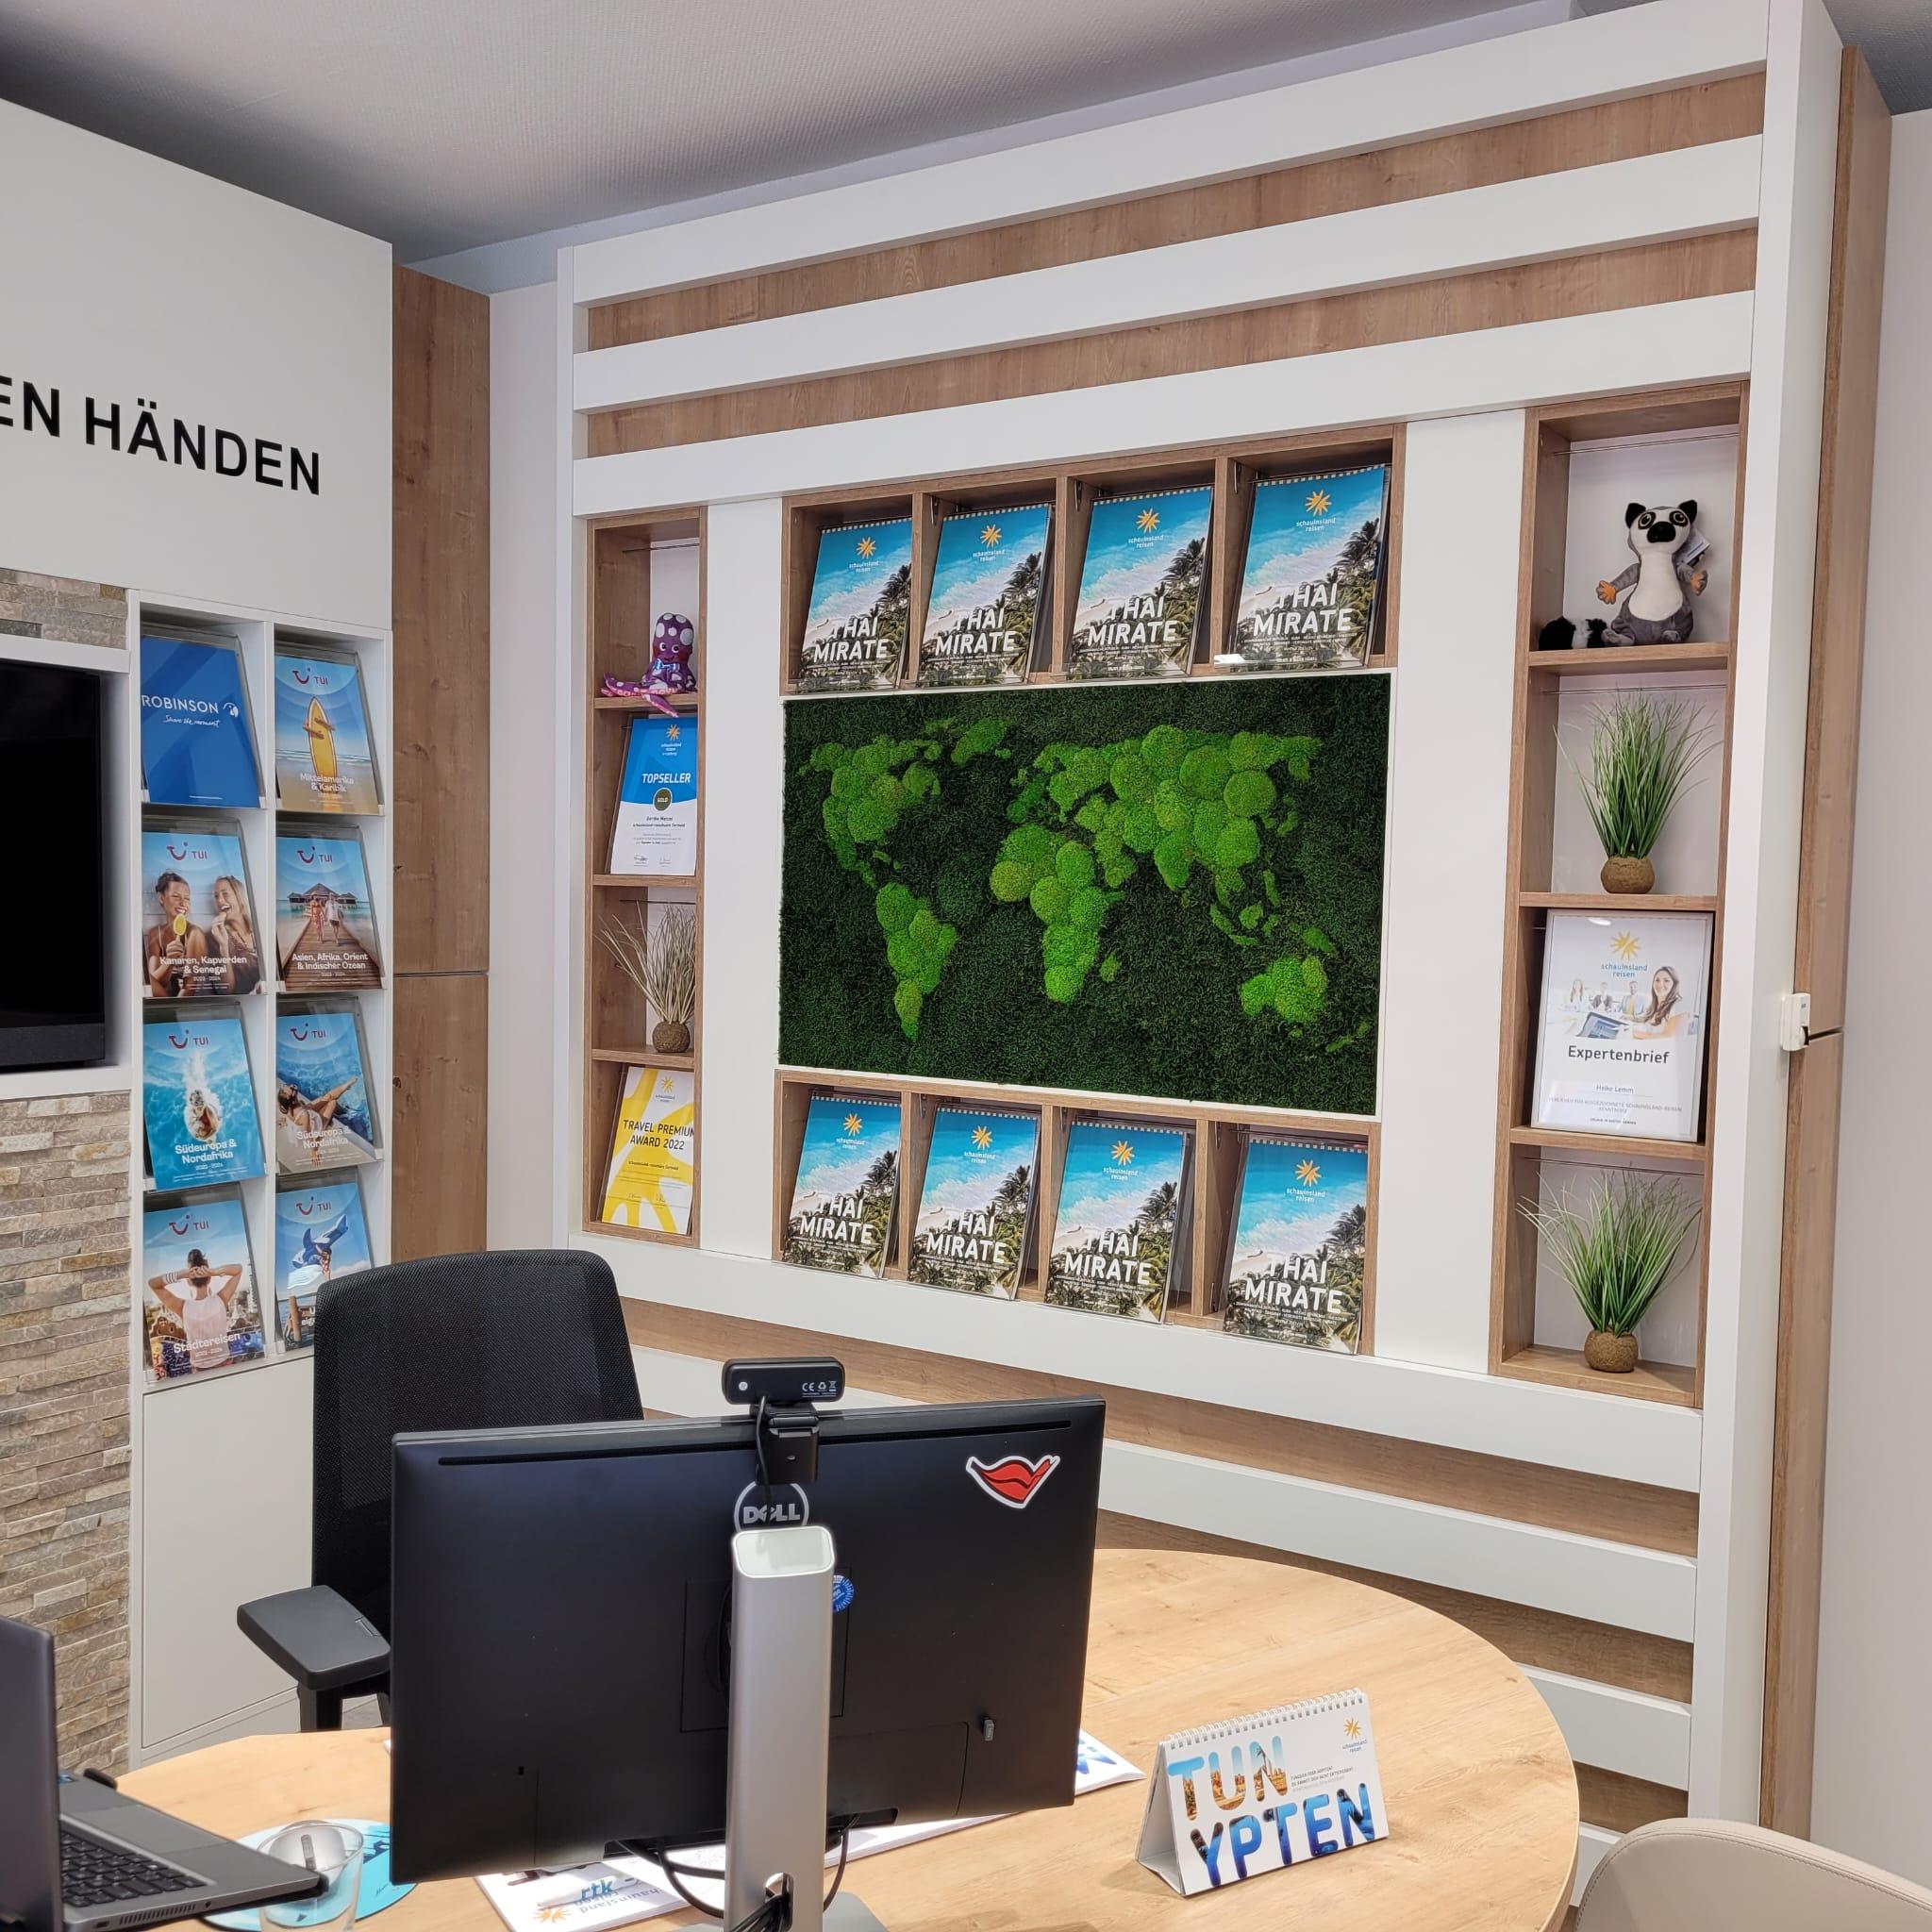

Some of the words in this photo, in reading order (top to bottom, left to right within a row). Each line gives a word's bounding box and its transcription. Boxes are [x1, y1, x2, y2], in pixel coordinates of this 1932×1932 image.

[85, 397, 319, 495] HÄNDEN
[1296, 517, 1336, 527] schauinsland
[1253, 608, 1353, 637] MIRATE
[1088, 620, 1178, 646] MIRATE
[935, 630, 1017, 657] MIRATE
[813, 639, 889, 662] MIRATE
[314, 675, 329, 685] TUI
[141, 694, 219, 714] ROBINSON
[300, 773, 355, 785] Mittelamerika
[641, 772, 691, 784] TOPSELLER
[319, 782, 347, 792] Karibik
[192, 850, 208, 859] TUI
[318, 854, 333, 863] TUI
[159, 957, 200, 966] Kanaren,
[201, 955, 247, 966] Kapverden
[291, 953, 316, 961] Asien,
[317, 953, 342, 961] Afrika,
[343, 952, 369, 960] Orient
[193, 965, 226, 975] Senegal
[297, 961, 305, 970] &
[306, 961, 341, 970] Indischer
[341, 961, 366, 970] Ozean
[1601, 963, 1648, 973] schauinsland
[311, 1030, 326, 1039] TUI
[193, 1037, 209, 1046] TUI
[1568, 1045, 1670, 1064] Expertenbrief
[624, 1120, 654, 1133] TRAVEL
[175, 1140, 227, 1155] Südeuropa
[228, 1139, 237, 1148] &
[630, 1135, 660, 1147] AWARD
[663, 1139, 685, 1150] 2022
[181, 1150, 233, 1164] Nordafrika
[1286, 1188, 1326, 1198] schauinsland
[317, 1203, 332, 1212] TUI
[193, 1220, 209, 1230] TUI
[800, 1215, 874, 1245] MIRATE
[926, 1232, 1008, 1264] MIRATE
[1064, 1252, 1153, 1285] MIRATE
[1245, 1277, 1343, 1314] MIRATE
[174, 1333, 241, 1354] Städtereisen
[1167, 1736, 1288, 1821] TUN
[1191, 1783, 1375, 1888] YPTEN
